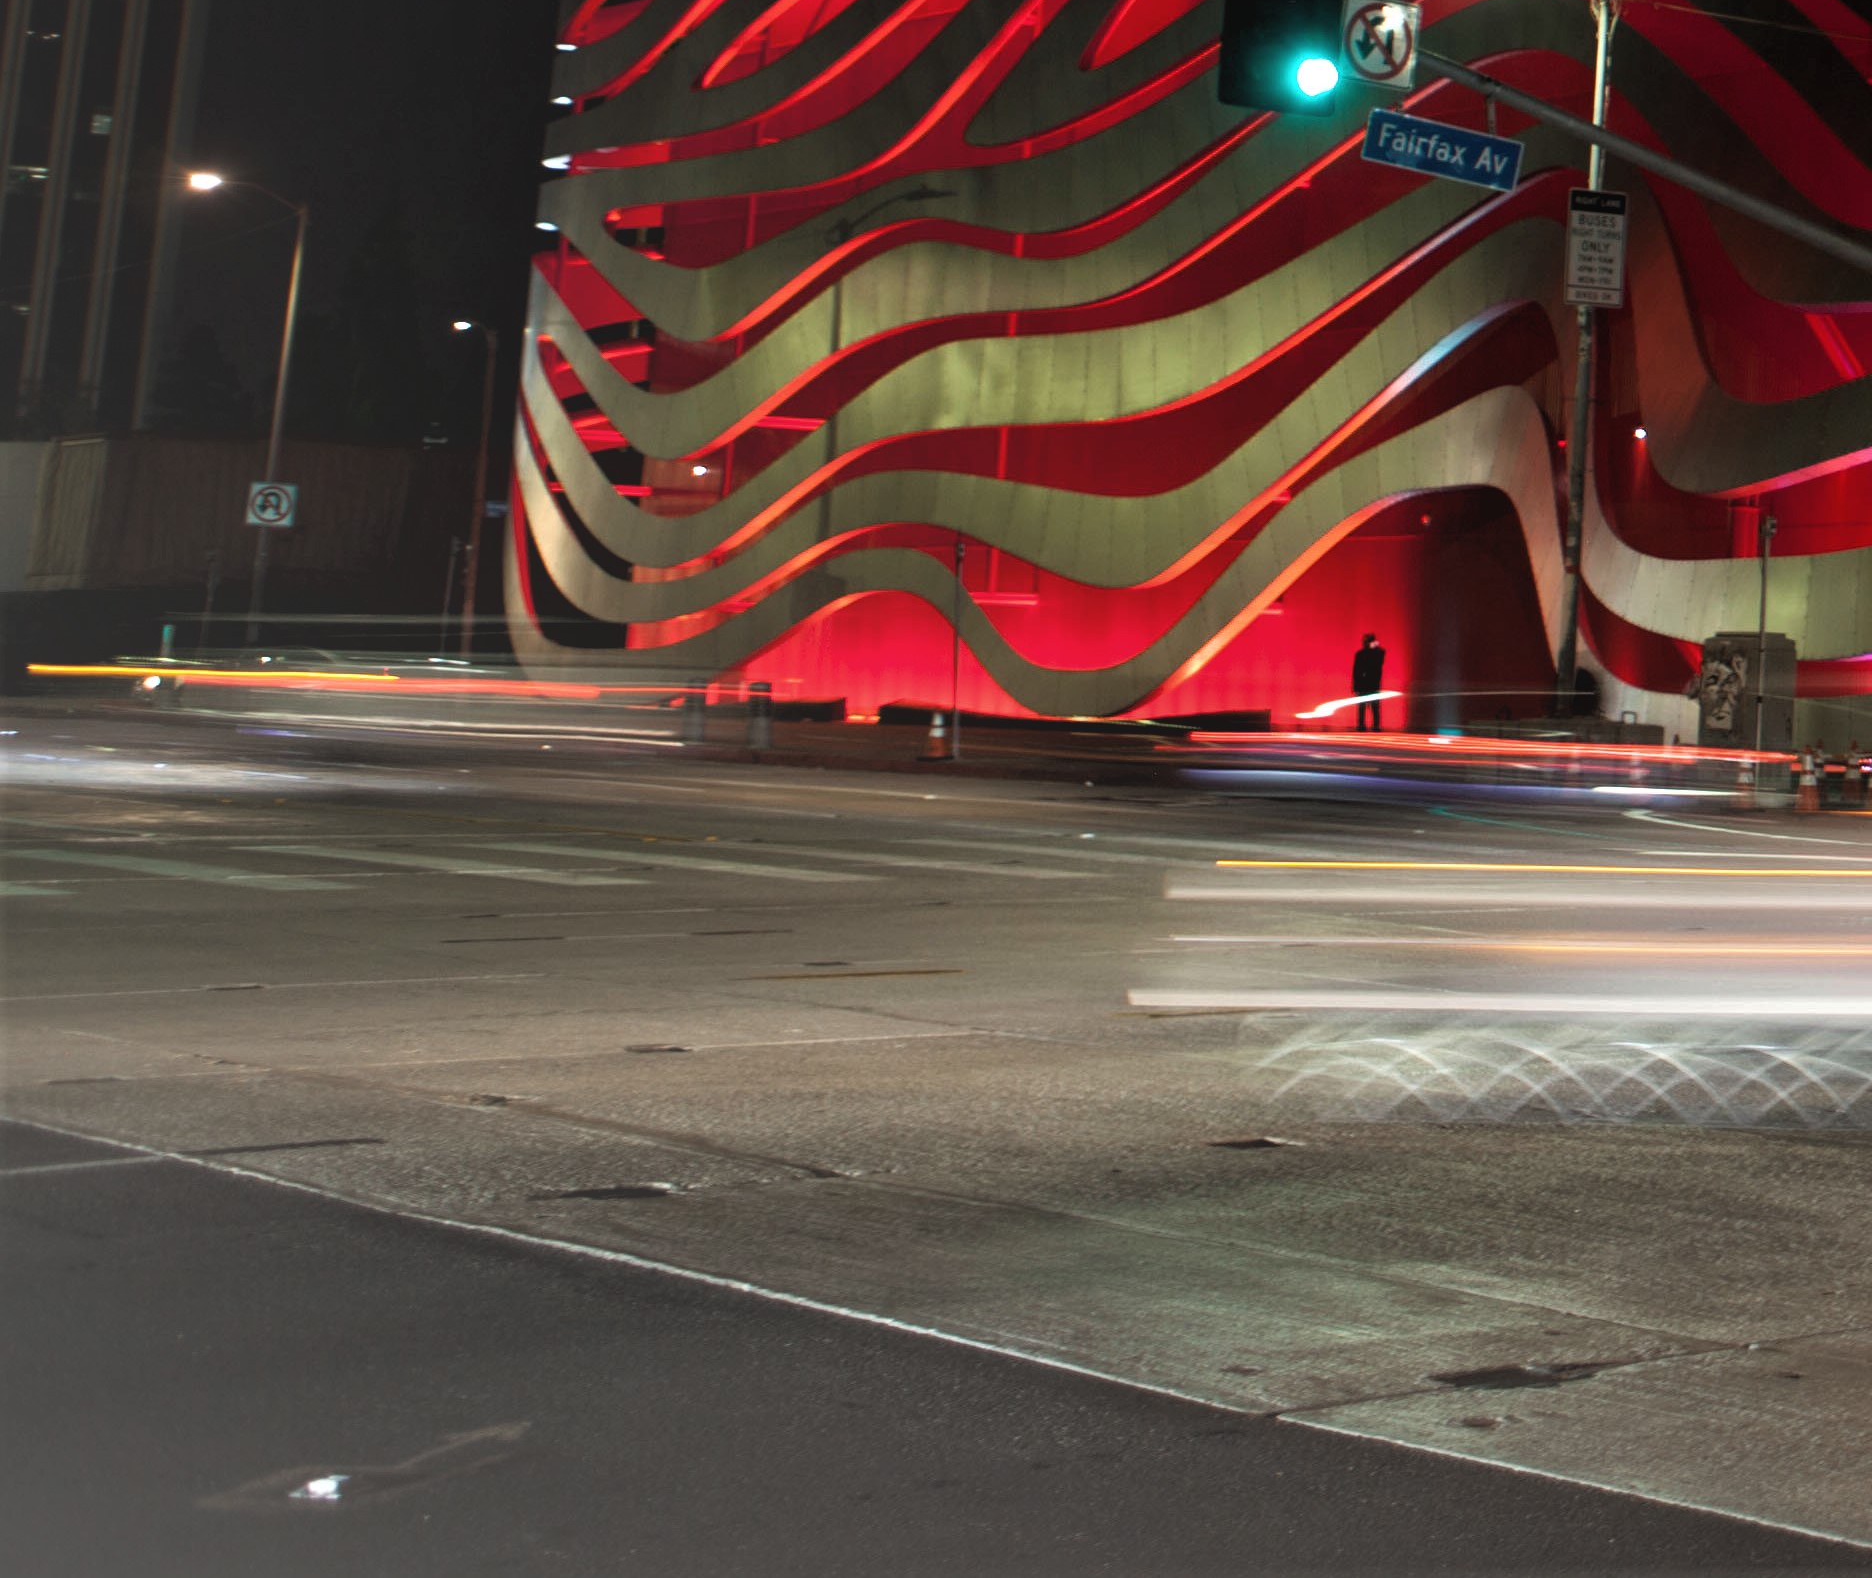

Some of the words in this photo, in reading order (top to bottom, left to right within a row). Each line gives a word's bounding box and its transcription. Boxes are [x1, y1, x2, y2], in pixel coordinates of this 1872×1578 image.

[1377, 123, 1467, 166] Fairfax
[1474, 146, 1509, 175] Av
[1578, 214, 1616, 228] BUSES
[1581, 240, 1611, 253] ONLY
